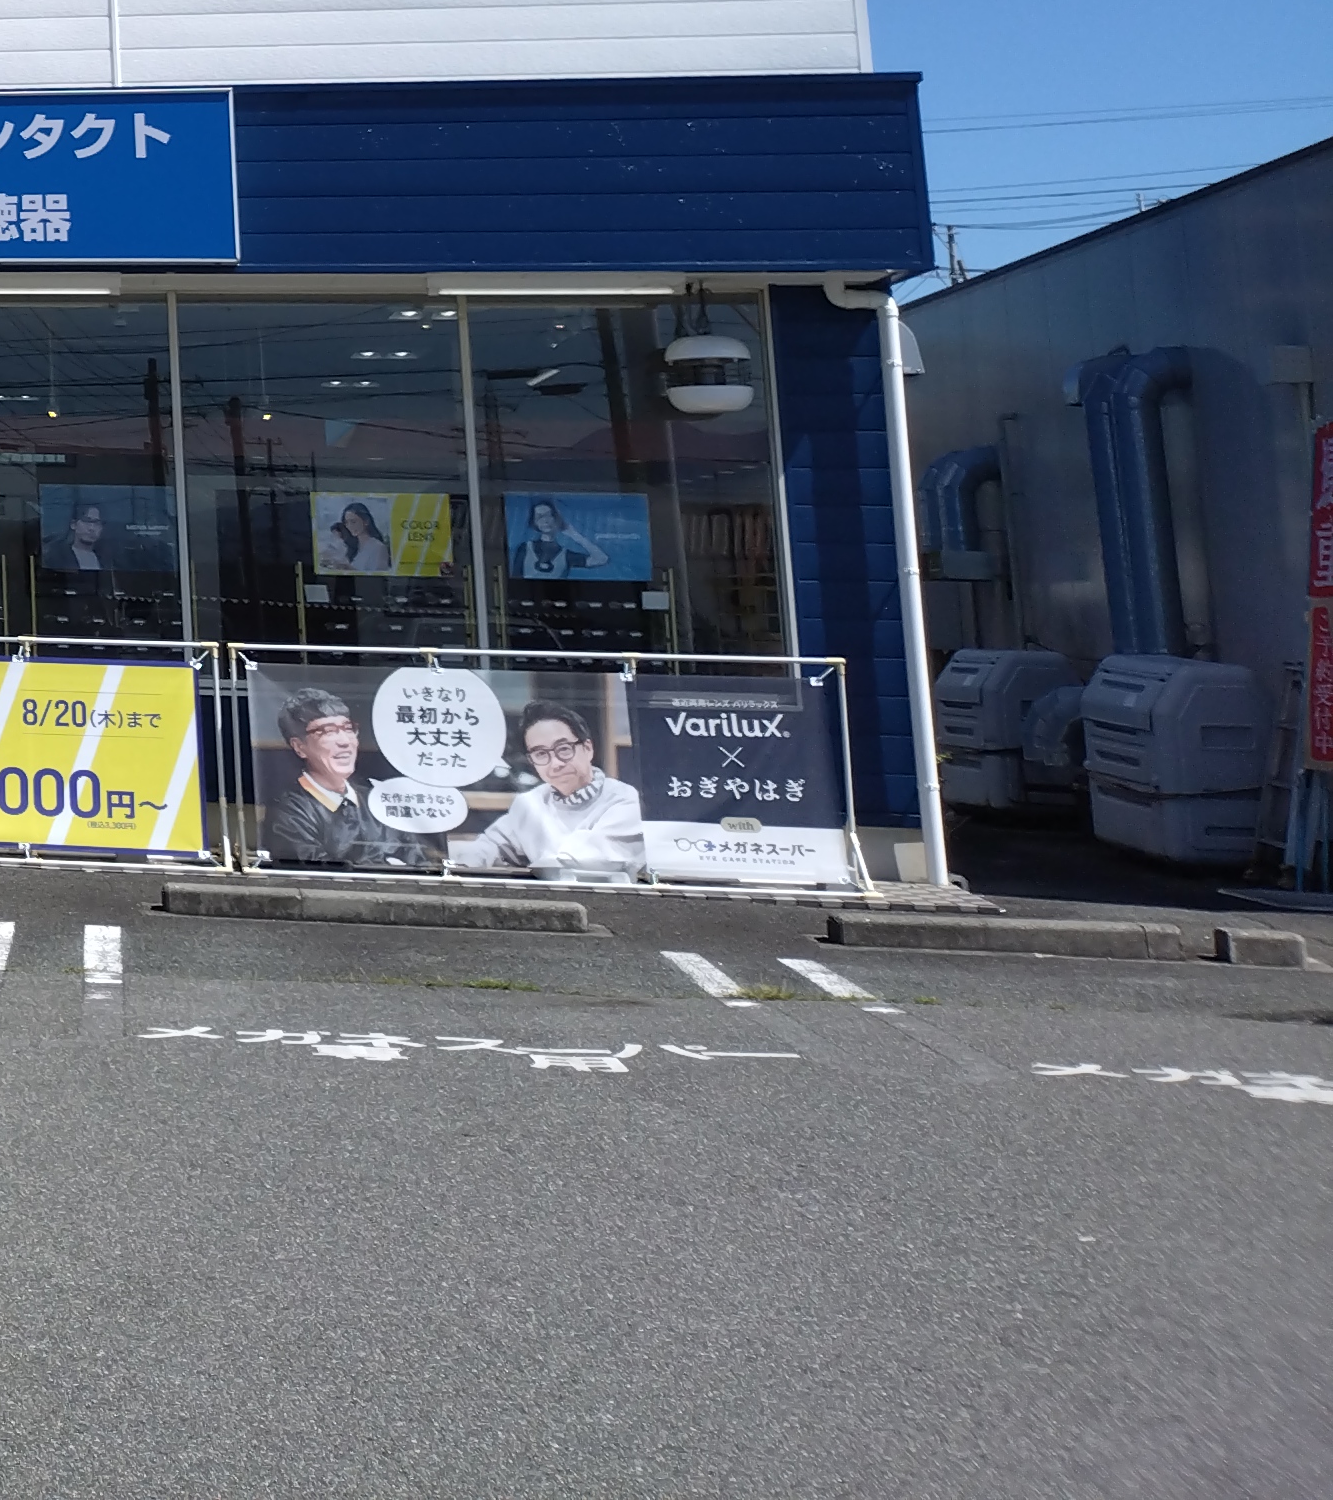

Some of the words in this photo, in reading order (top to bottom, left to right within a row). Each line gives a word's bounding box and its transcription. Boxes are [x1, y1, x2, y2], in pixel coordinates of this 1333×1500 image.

[402, 687, 466, 702] いきなり
[395, 705, 480, 726] 最初から
[406, 727, 472, 748] 大丈夫
[417, 752, 468, 768] だった
[666, 775, 807, 803] おぎやはぎ
[726, 820, 755, 832] with
[718, 841, 816, 857] メガネスーパー
